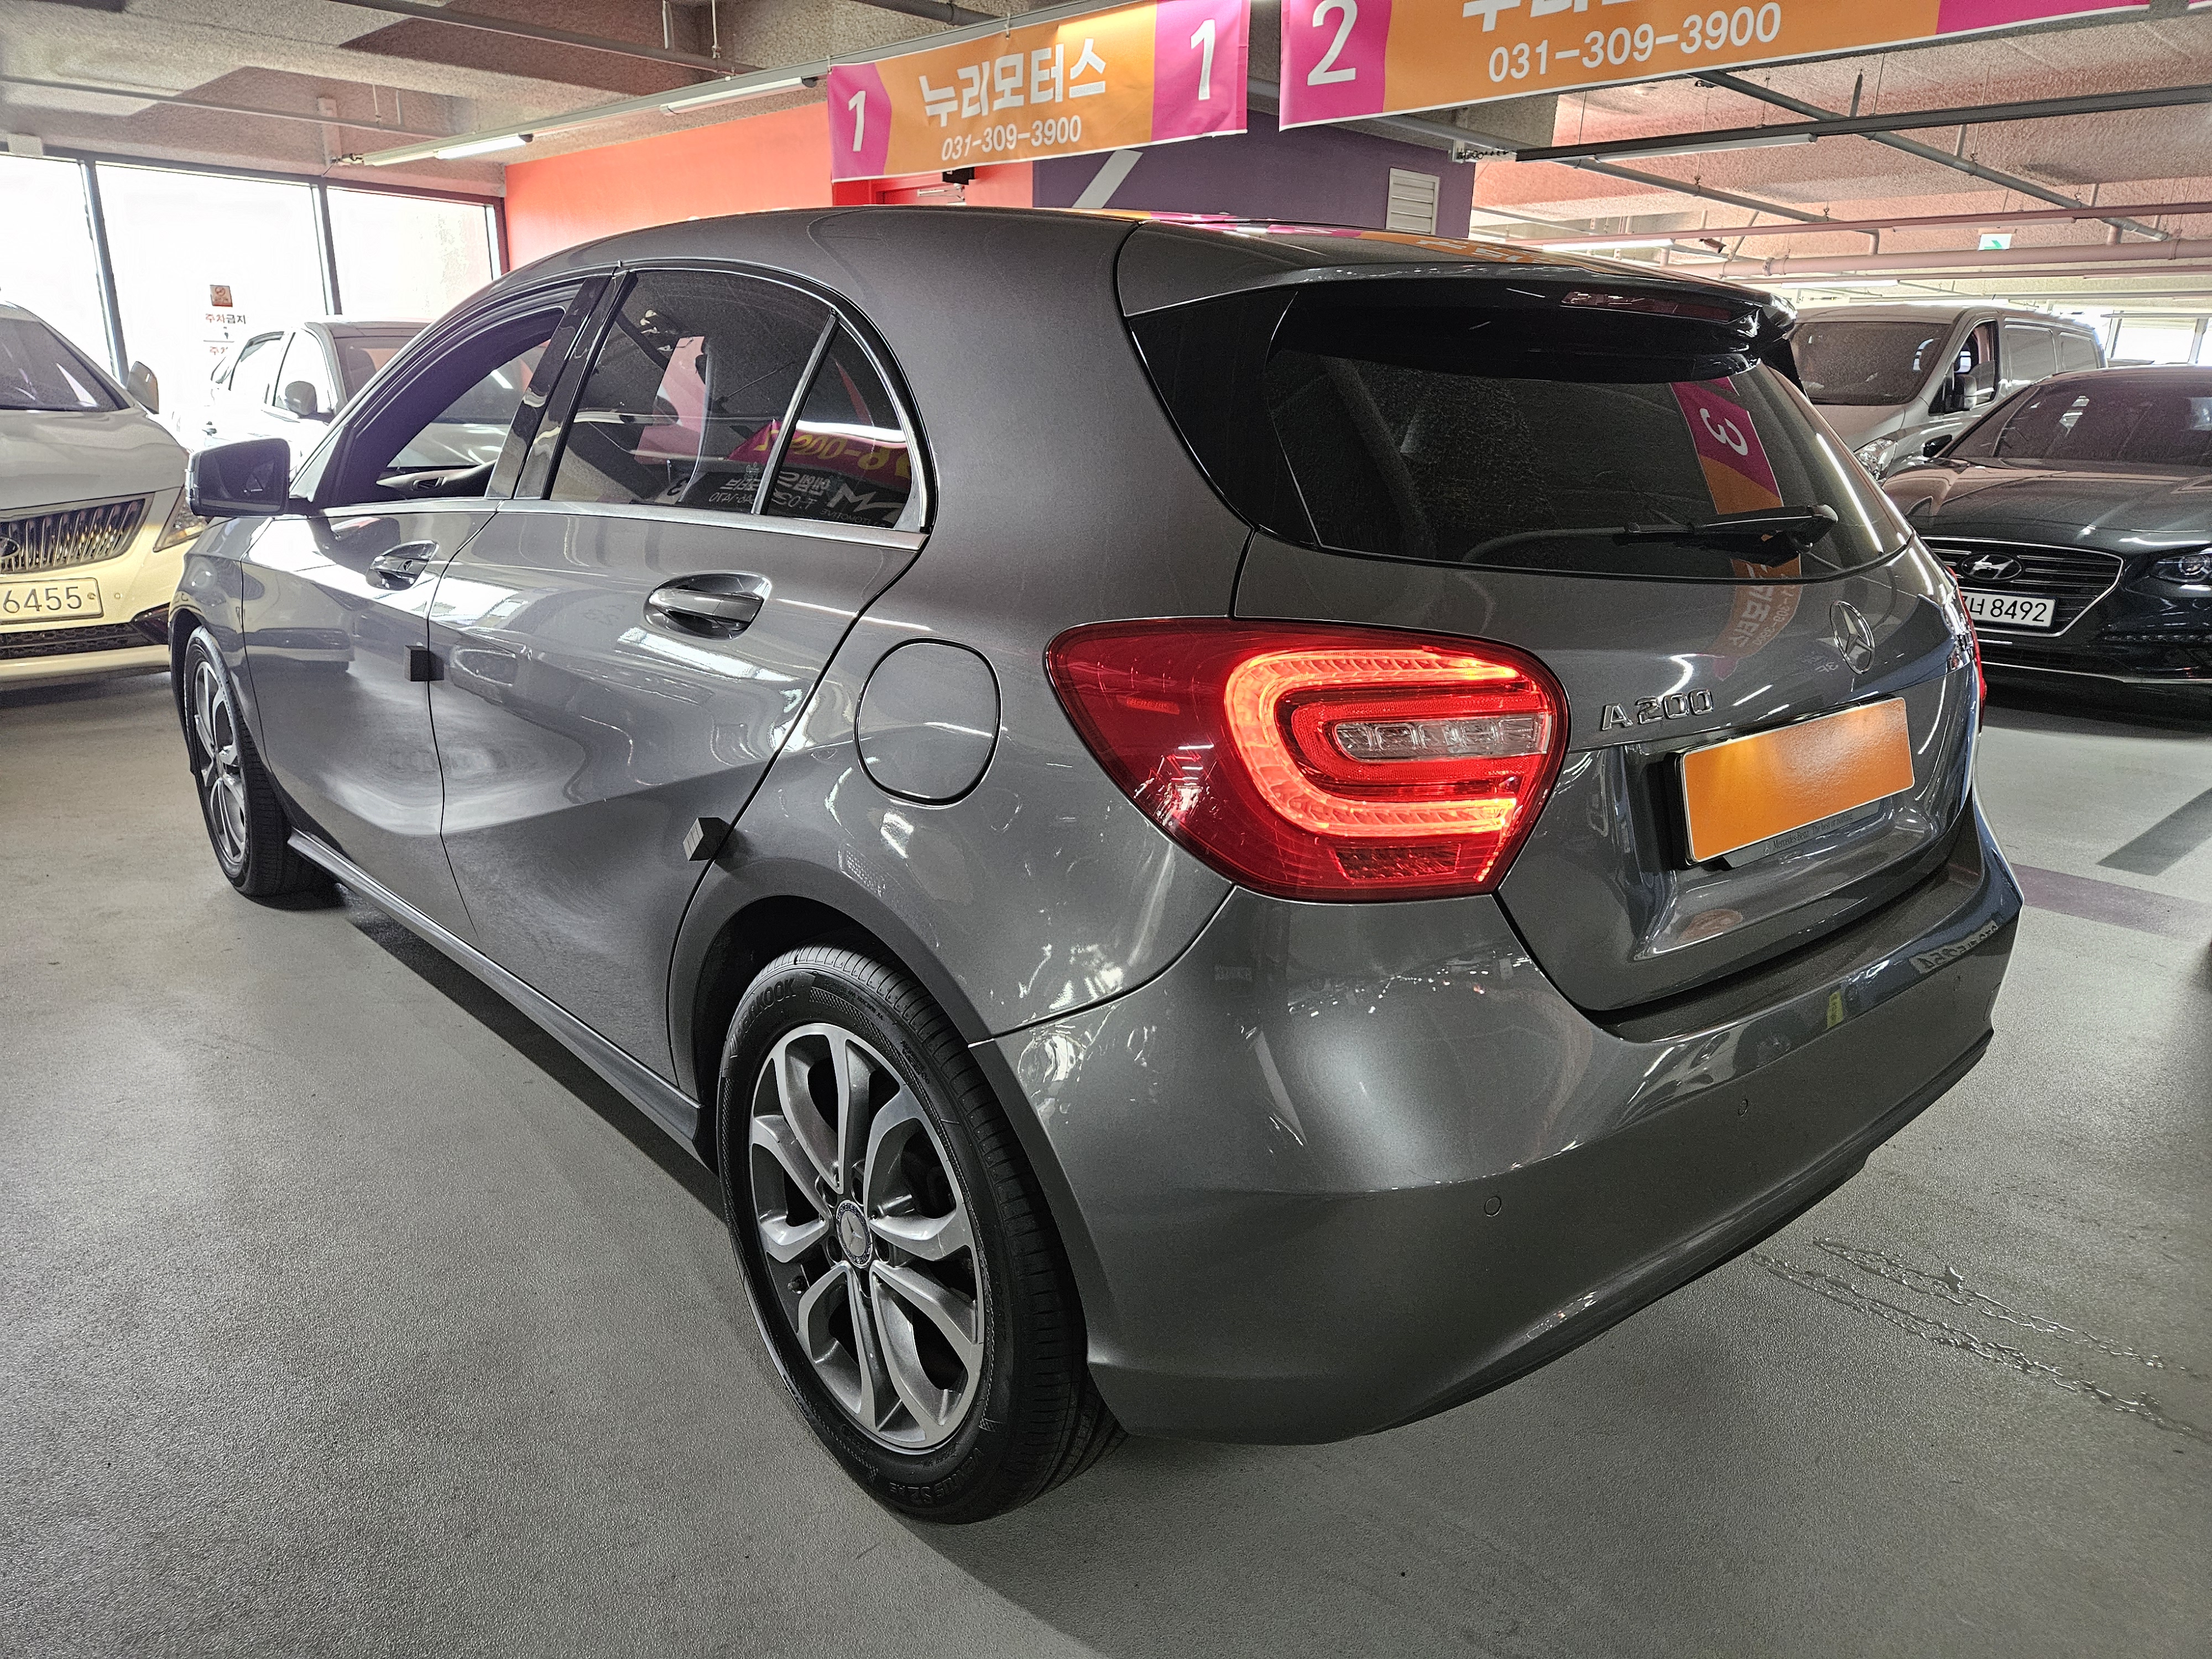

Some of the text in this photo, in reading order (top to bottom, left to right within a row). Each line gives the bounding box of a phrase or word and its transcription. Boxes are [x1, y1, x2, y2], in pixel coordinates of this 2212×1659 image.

[1190, 19, 1216, 101] 1
[1307, 0, 1358, 86] 2
[1488, 2, 1782, 84] 031-309-3900
[919, 38, 1107, 128] 누리모터스
[848, 90, 866, 152] 1
[941, 115, 1082, 161] 031-309-3900
[3, 586, 82, 613] 6455
[1963, 596, 2047, 622] 너 8492
[1773, 830, 1809, 850] Mercedes-Benz
[837, 1203, 858, 1223] MERCEDES
[855, 1253, 869, 1264] BENZ
